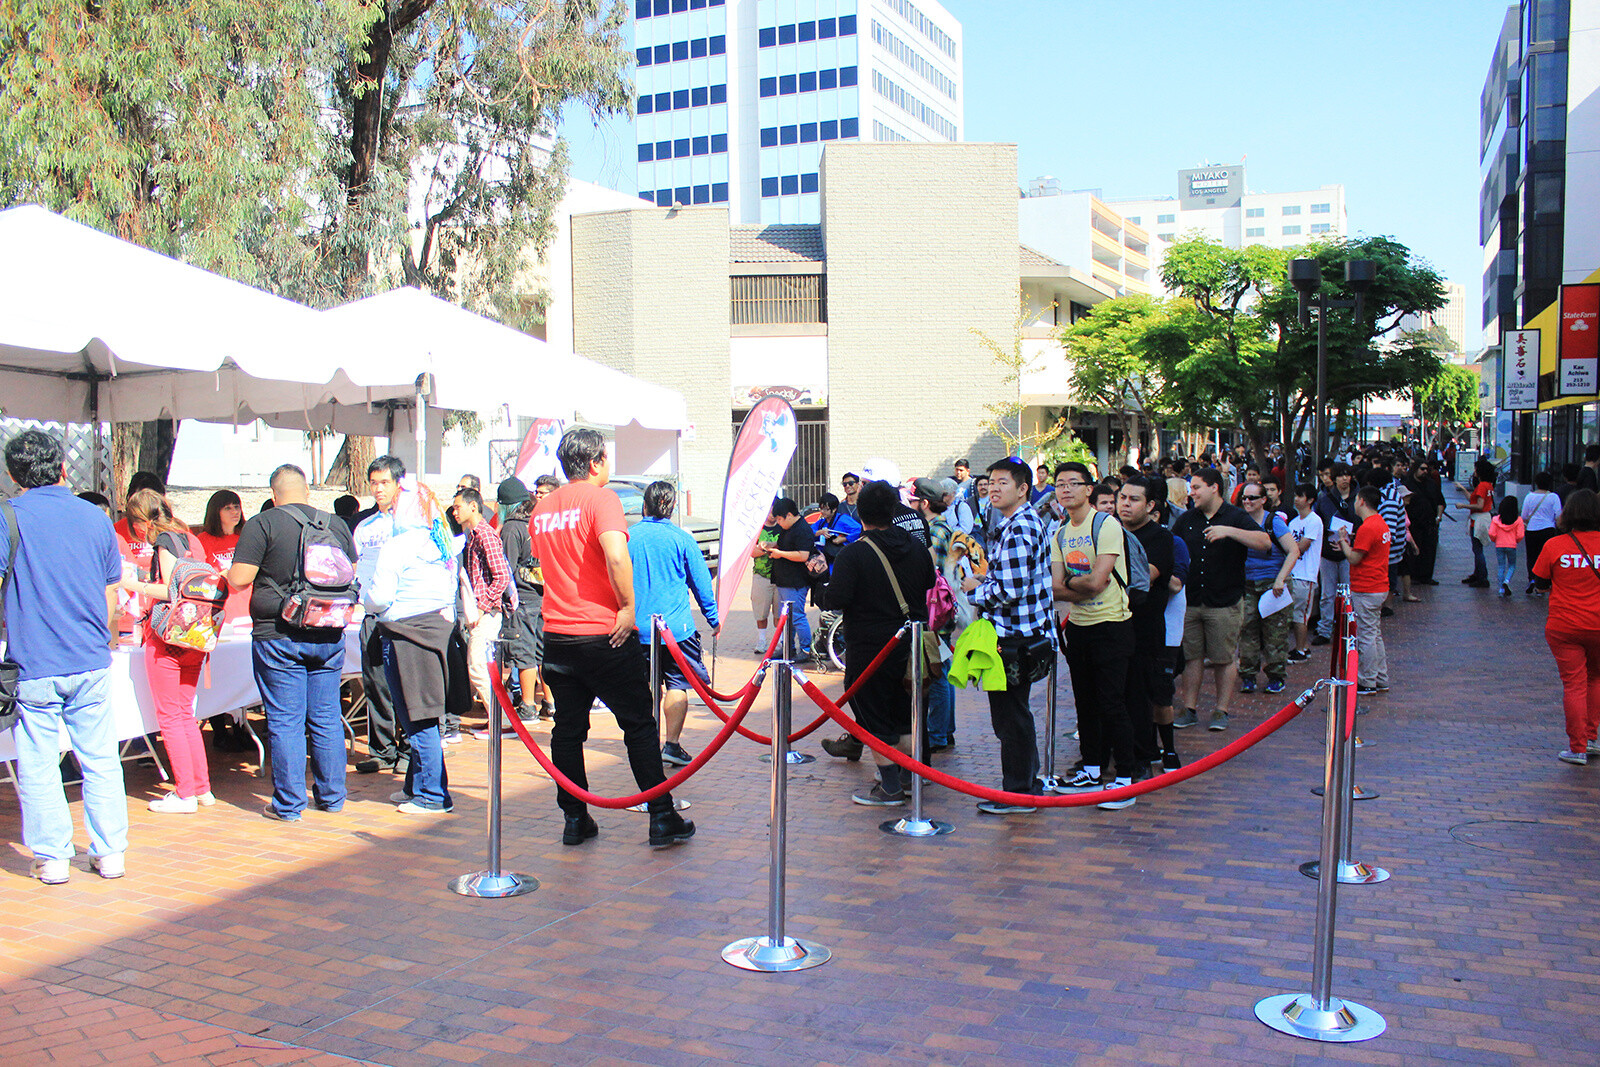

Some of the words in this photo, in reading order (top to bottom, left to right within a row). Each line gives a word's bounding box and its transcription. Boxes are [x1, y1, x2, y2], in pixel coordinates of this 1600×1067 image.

[1192, 170, 1228, 181] MIYAKO
[737, 469, 767, 527] TICKET
[745, 502, 766, 541] PICK
[764, 470, 777, 494] UP
[533, 508, 581, 535] STAFF
